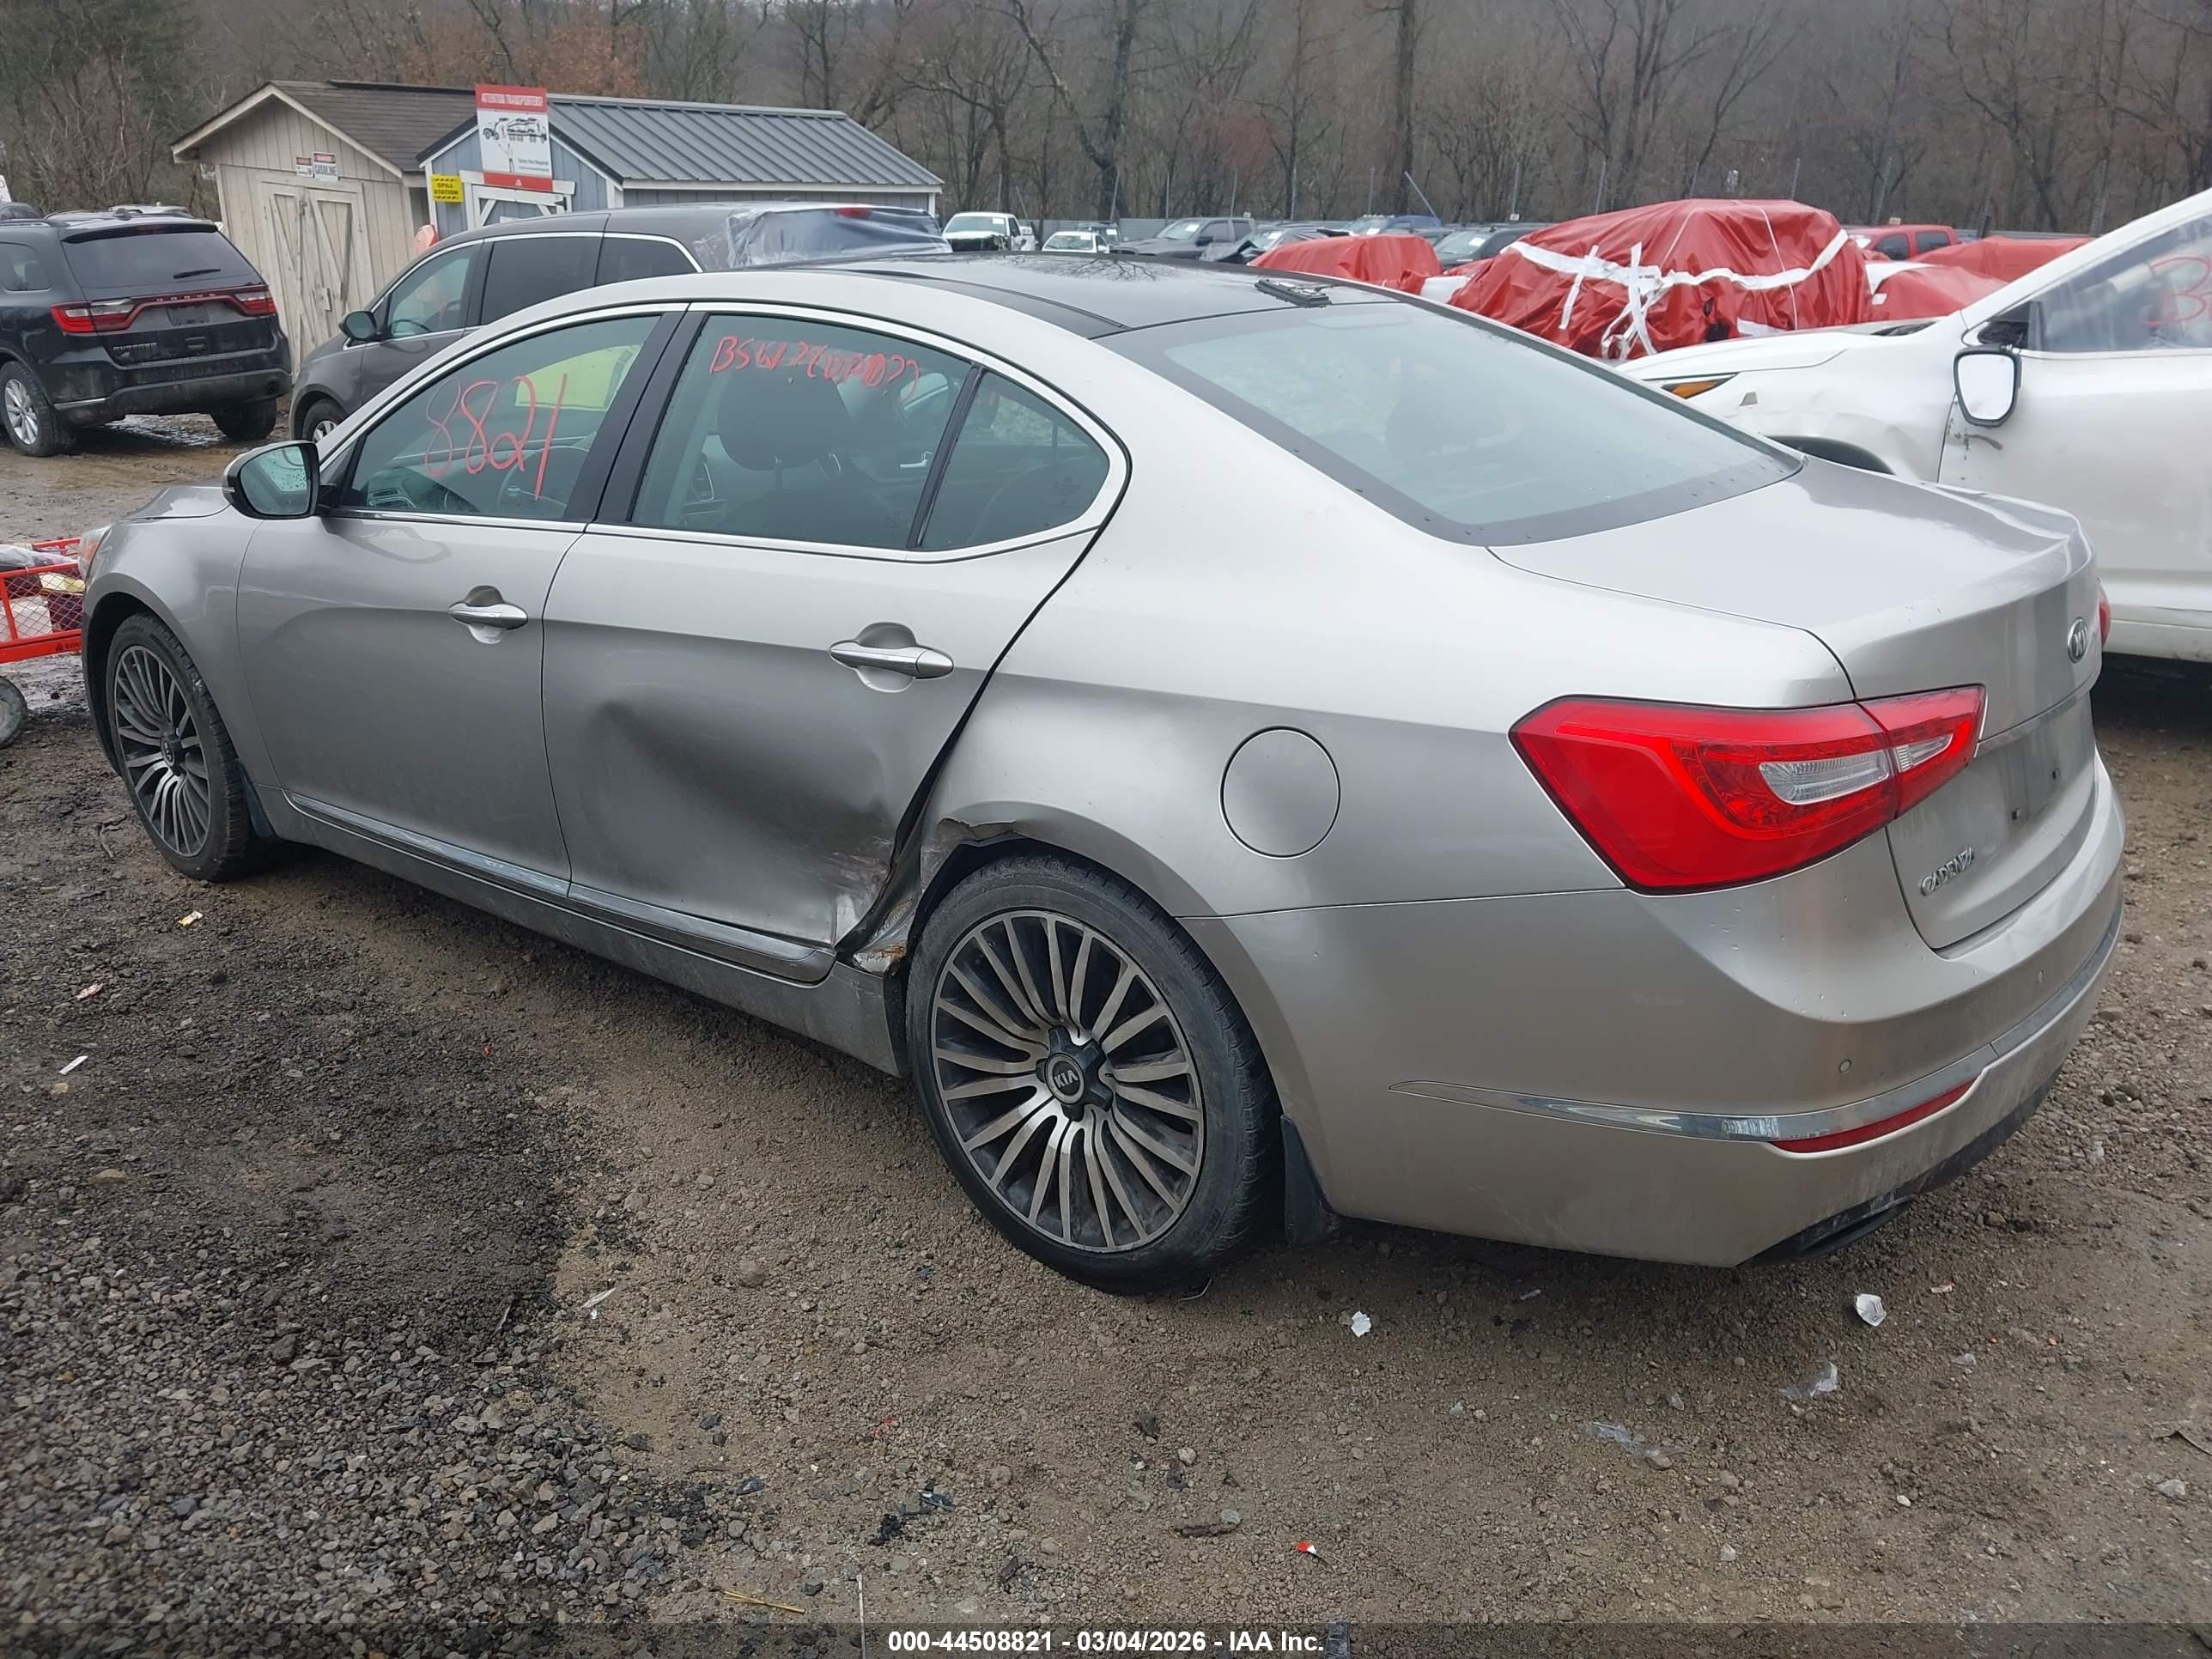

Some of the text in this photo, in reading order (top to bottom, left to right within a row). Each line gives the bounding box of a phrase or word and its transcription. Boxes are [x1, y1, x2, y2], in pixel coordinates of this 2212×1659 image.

[425, 373, 568, 501] 8821
[1920, 846, 1974, 896] CADENZA
[1054, 1069, 1079, 1089] KIA
